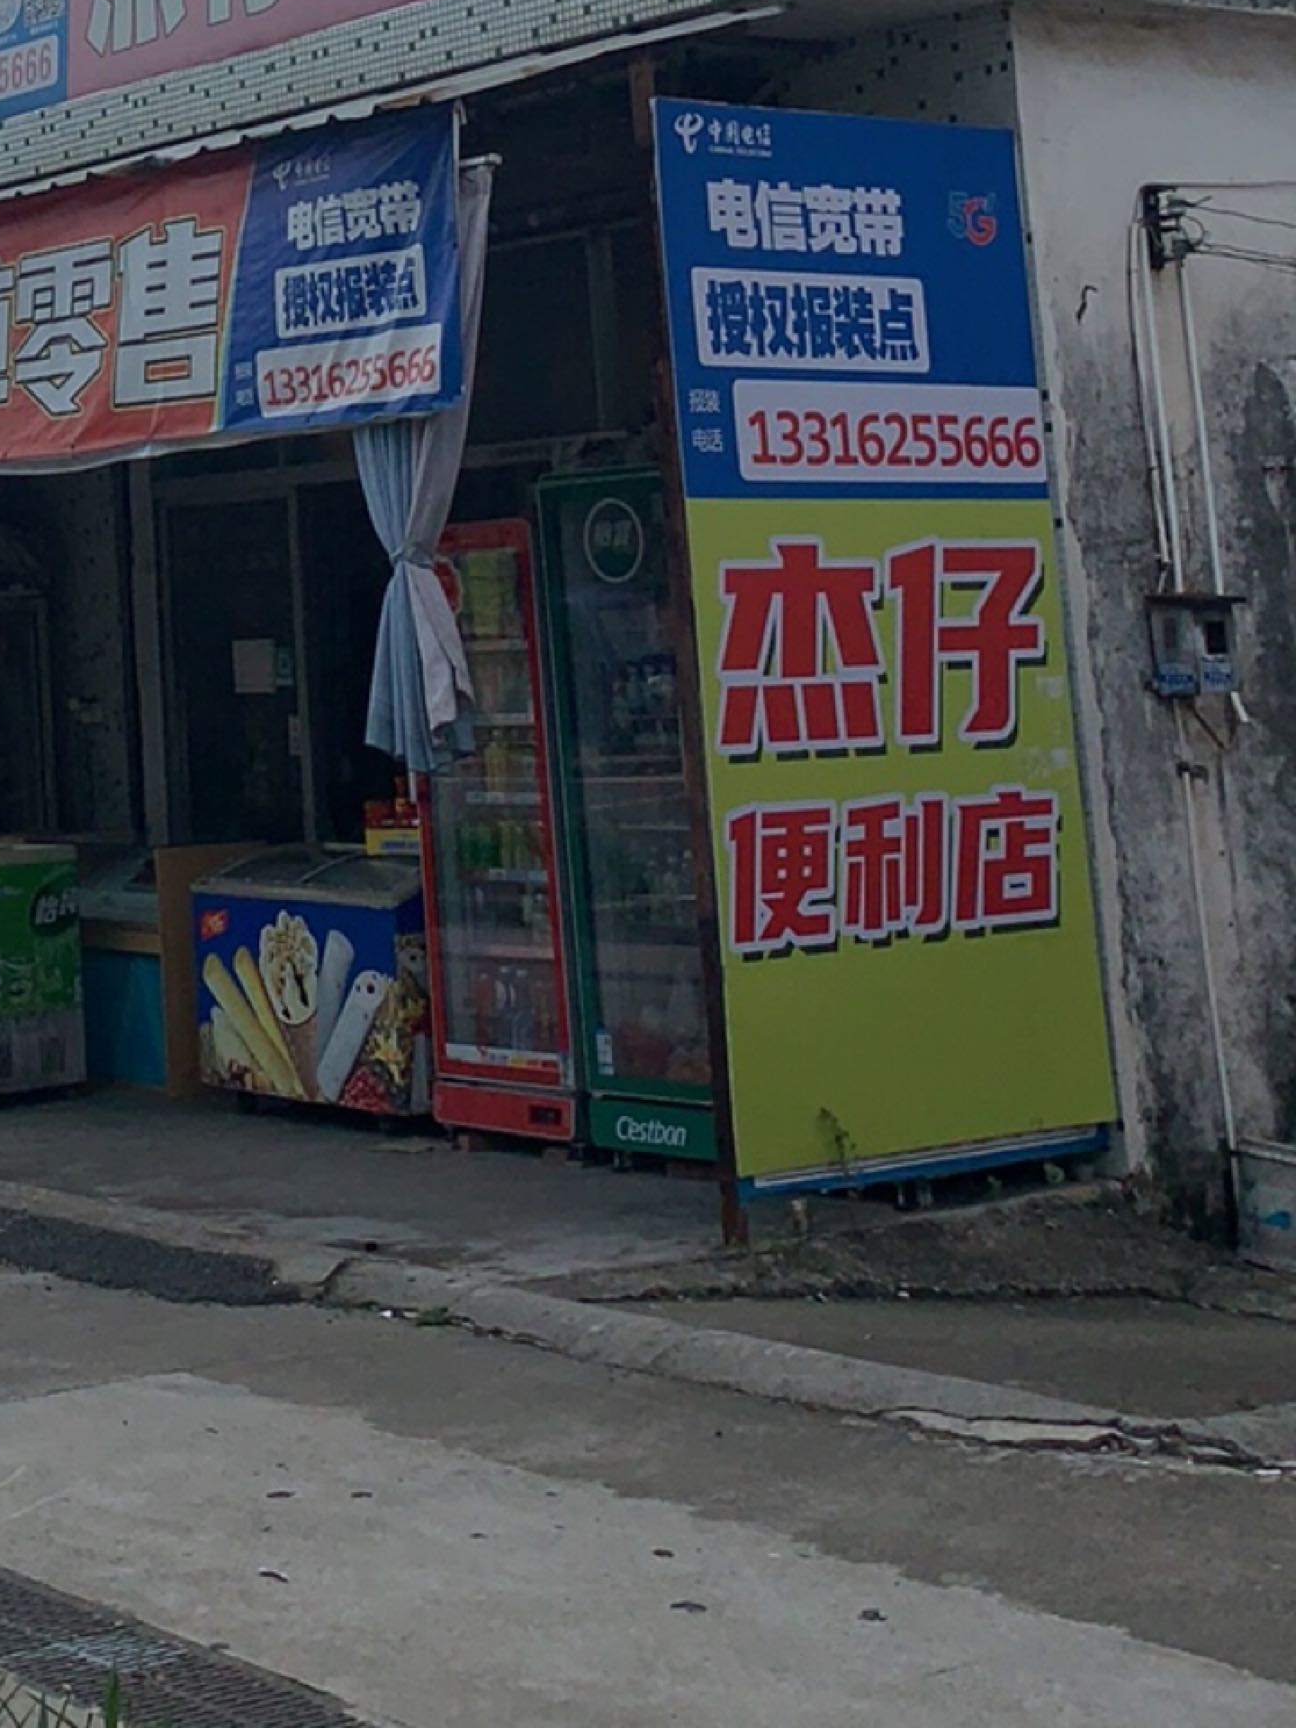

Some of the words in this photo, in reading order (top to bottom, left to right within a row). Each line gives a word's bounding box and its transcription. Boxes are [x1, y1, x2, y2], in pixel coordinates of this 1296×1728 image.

[287, 179, 421, 252] 电信宽带
[706, 178, 904, 257] 电信宽带
[706, 279, 920, 362] 授权报装点
[263, 344, 436, 406] 13316255666
[747, 410, 1042, 468] 13316255666
[717, 536, 1045, 754] 杰仔
[728, 786, 1058, 954] 便利店
